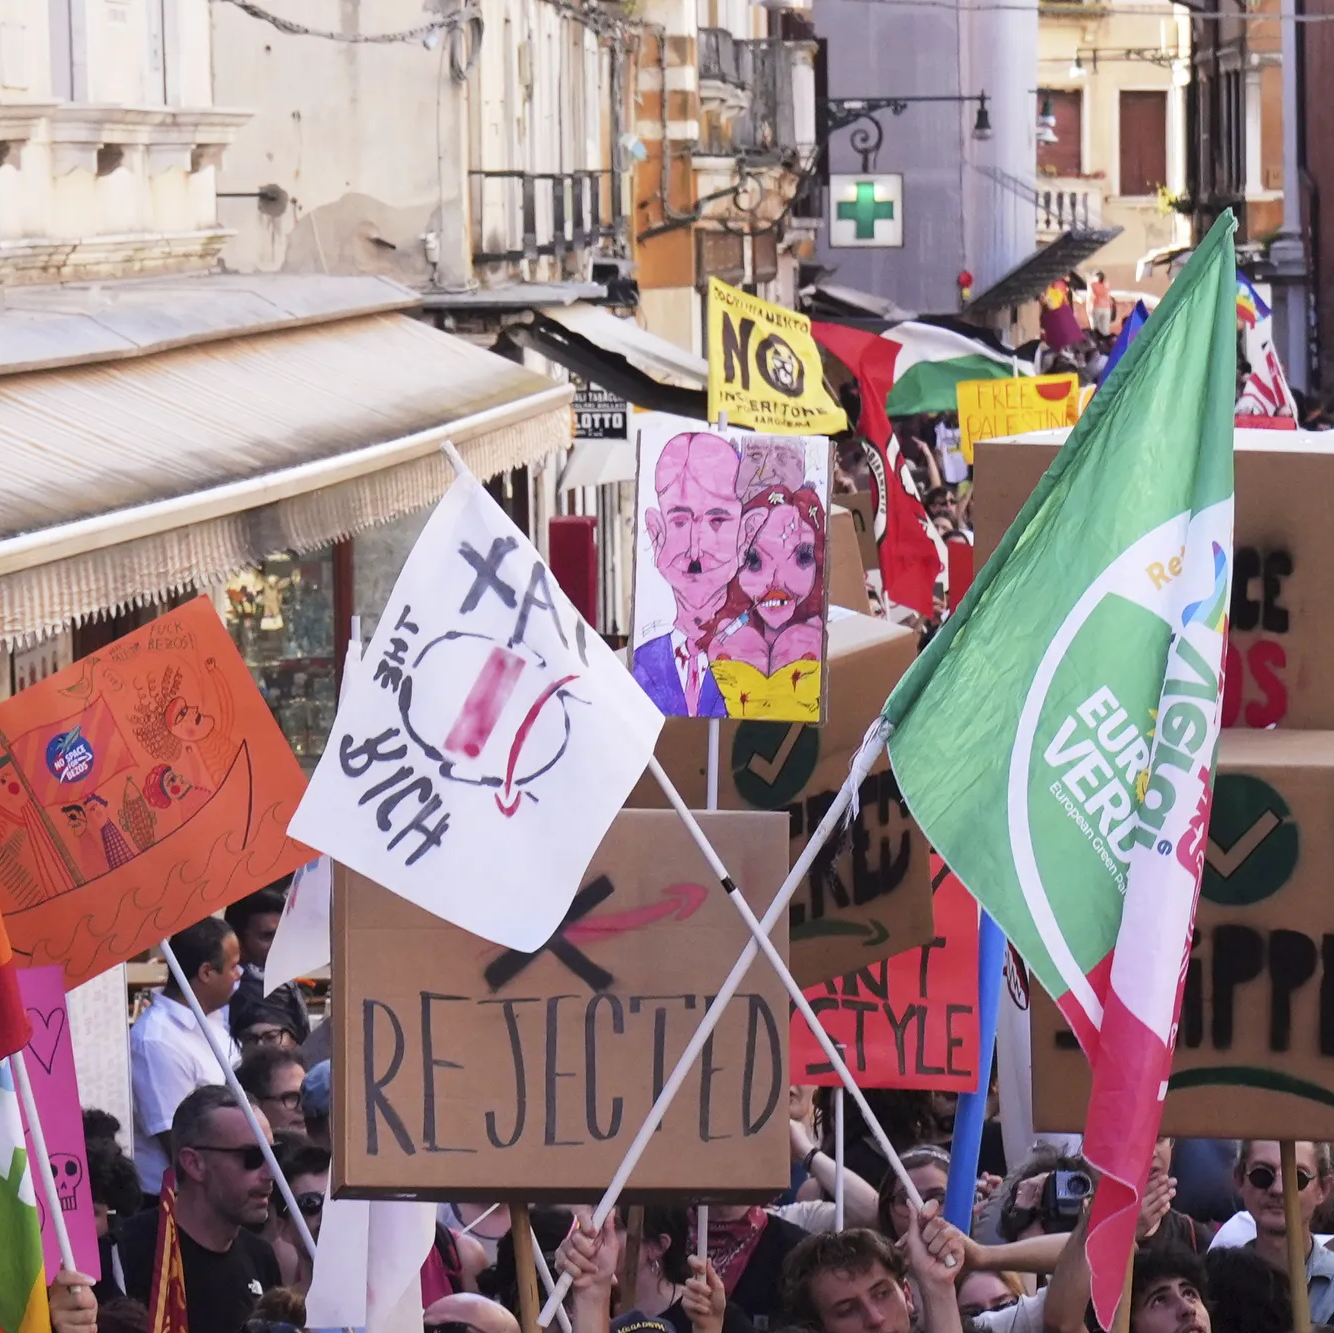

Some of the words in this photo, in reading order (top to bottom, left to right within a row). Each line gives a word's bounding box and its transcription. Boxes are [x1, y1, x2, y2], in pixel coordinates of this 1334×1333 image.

[722, 310, 805, 398] NO
[976, 382, 1034, 410] FREE
[575, 412, 623, 429] LOTTO
[54, 758, 65, 771] NO
[65, 744, 87, 761] SPACE
[66, 761, 88, 780] BEZOS
[1049, 781, 1094, 841] European
[1092, 836, 1117, 877] Green
[805, 996, 973, 1077] STYLE
[362, 991, 783, 1156] REJECTED
